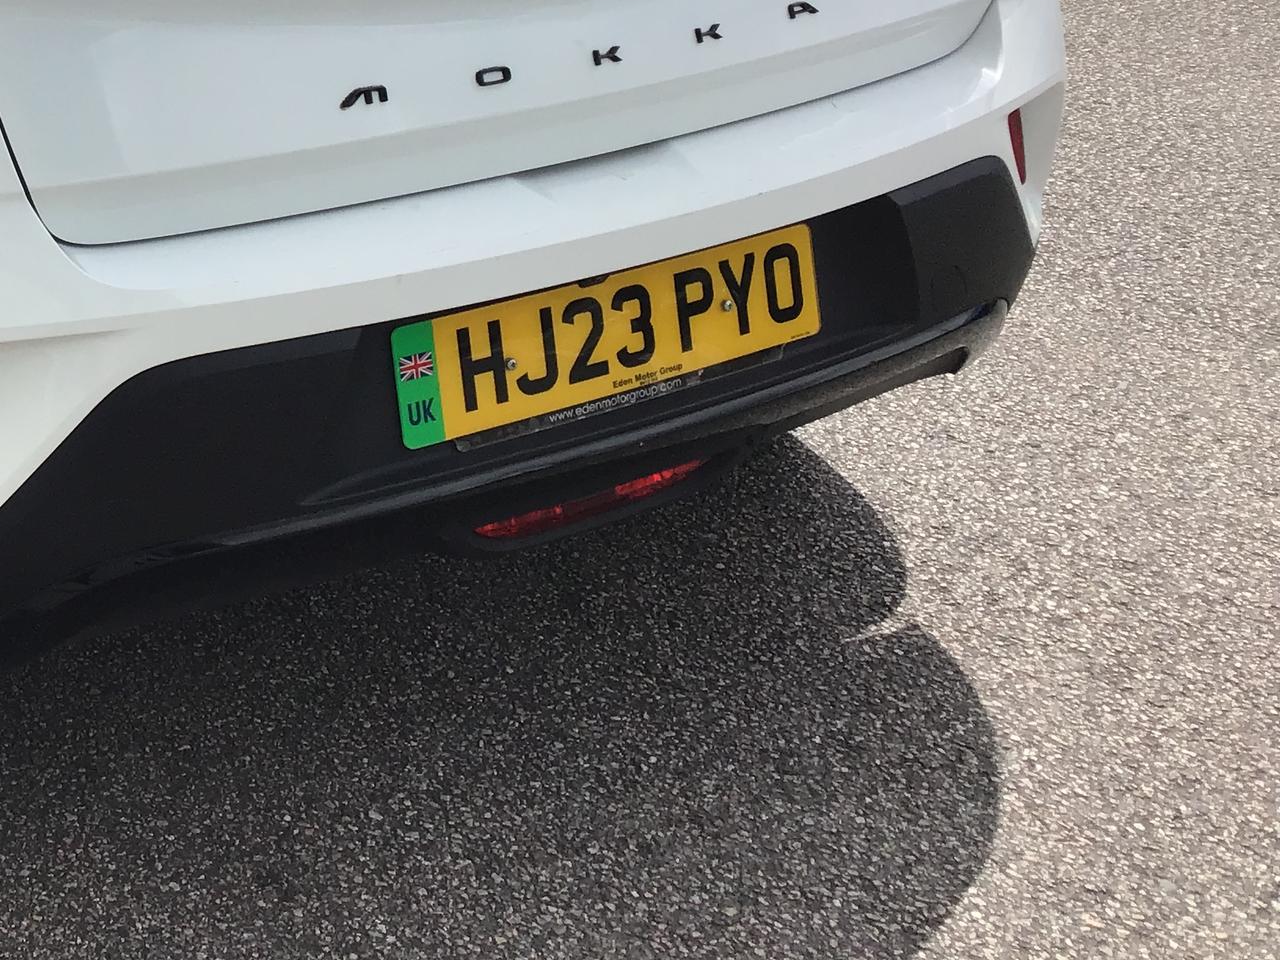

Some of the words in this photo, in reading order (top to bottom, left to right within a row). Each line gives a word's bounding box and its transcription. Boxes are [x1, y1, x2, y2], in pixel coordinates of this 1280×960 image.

[456, 284, 657, 413] HJ23
[673, 242, 804, 353] PYO
[612, 378, 633, 389] Eden
[634, 371, 658, 383] Motor
[659, 363, 683, 376] Group
[407, 397, 435, 427] UK
